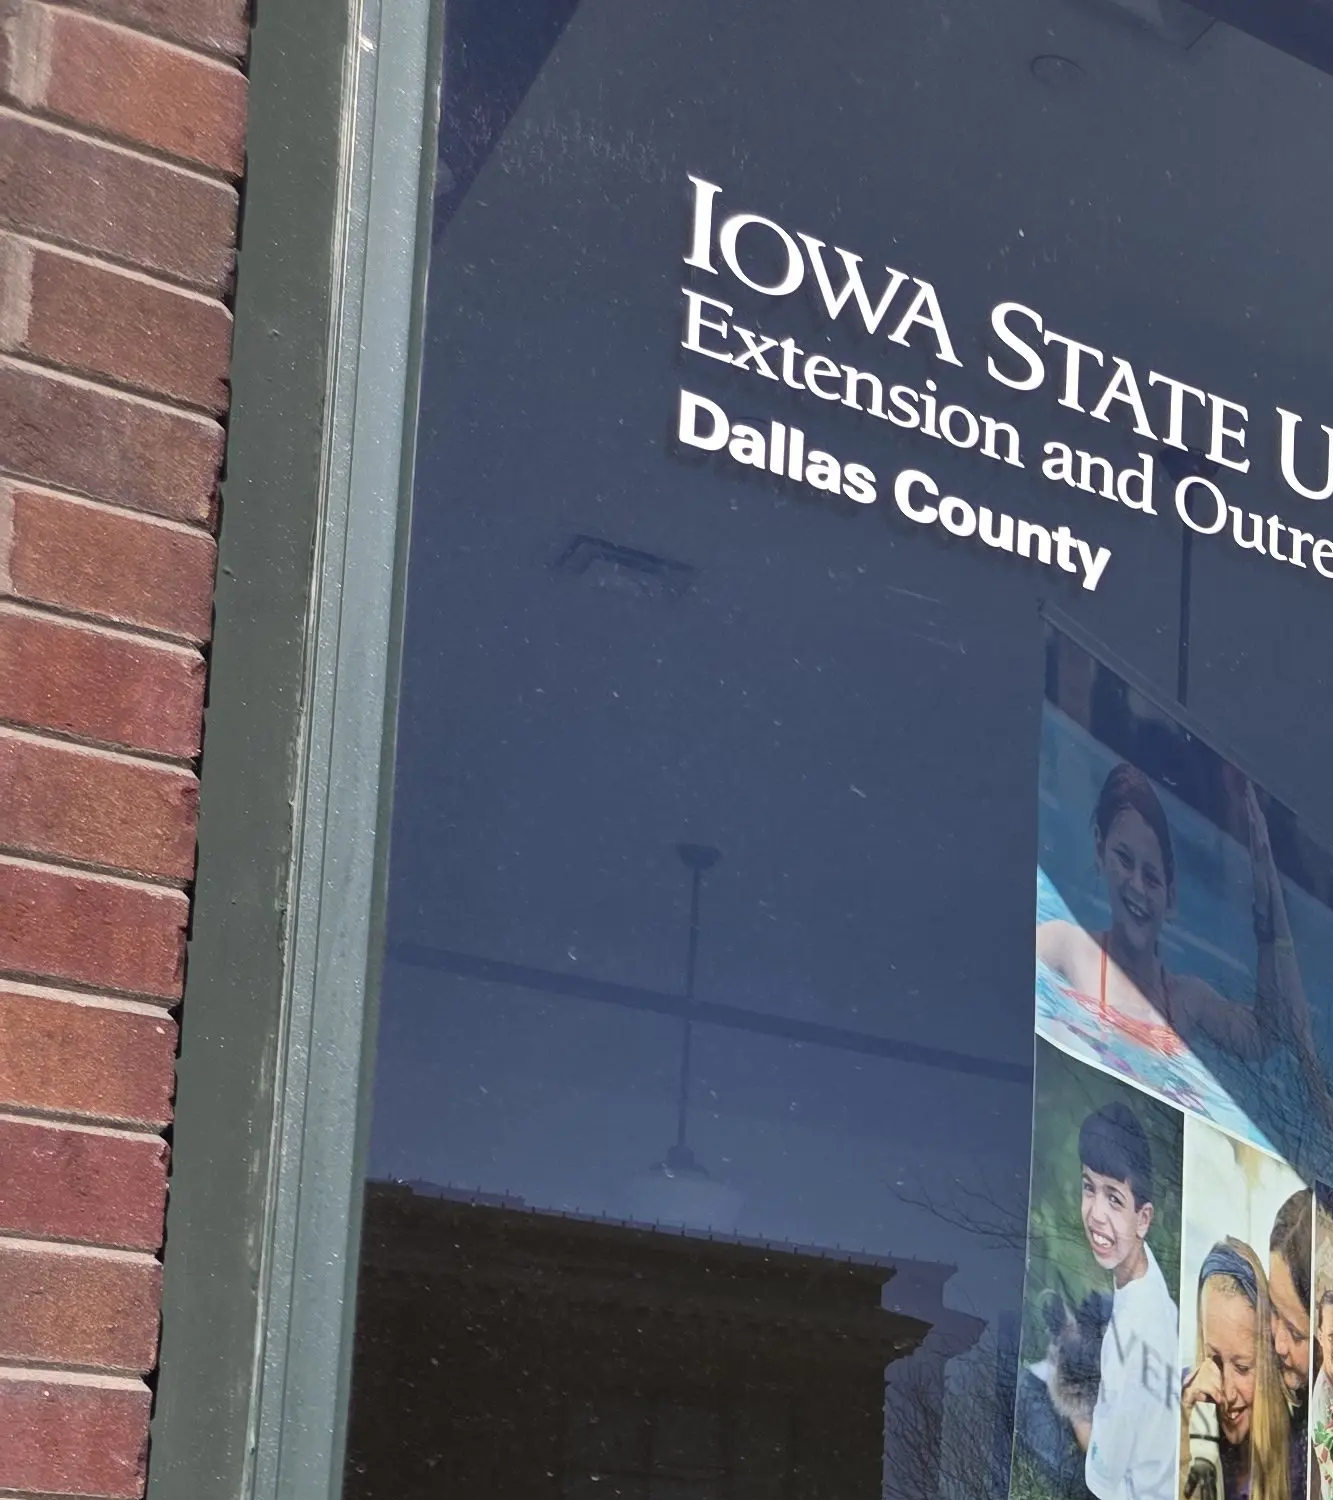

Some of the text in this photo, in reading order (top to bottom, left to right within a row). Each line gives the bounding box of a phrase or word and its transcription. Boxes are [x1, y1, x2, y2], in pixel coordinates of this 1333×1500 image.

[681, 287, 1025, 468] Extension
[1041, 440, 1158, 516] and
[683, 172, 963, 368] IOWA
[987, 302, 1250, 474] STATE
[678, 388, 1112, 592] Dallas County
